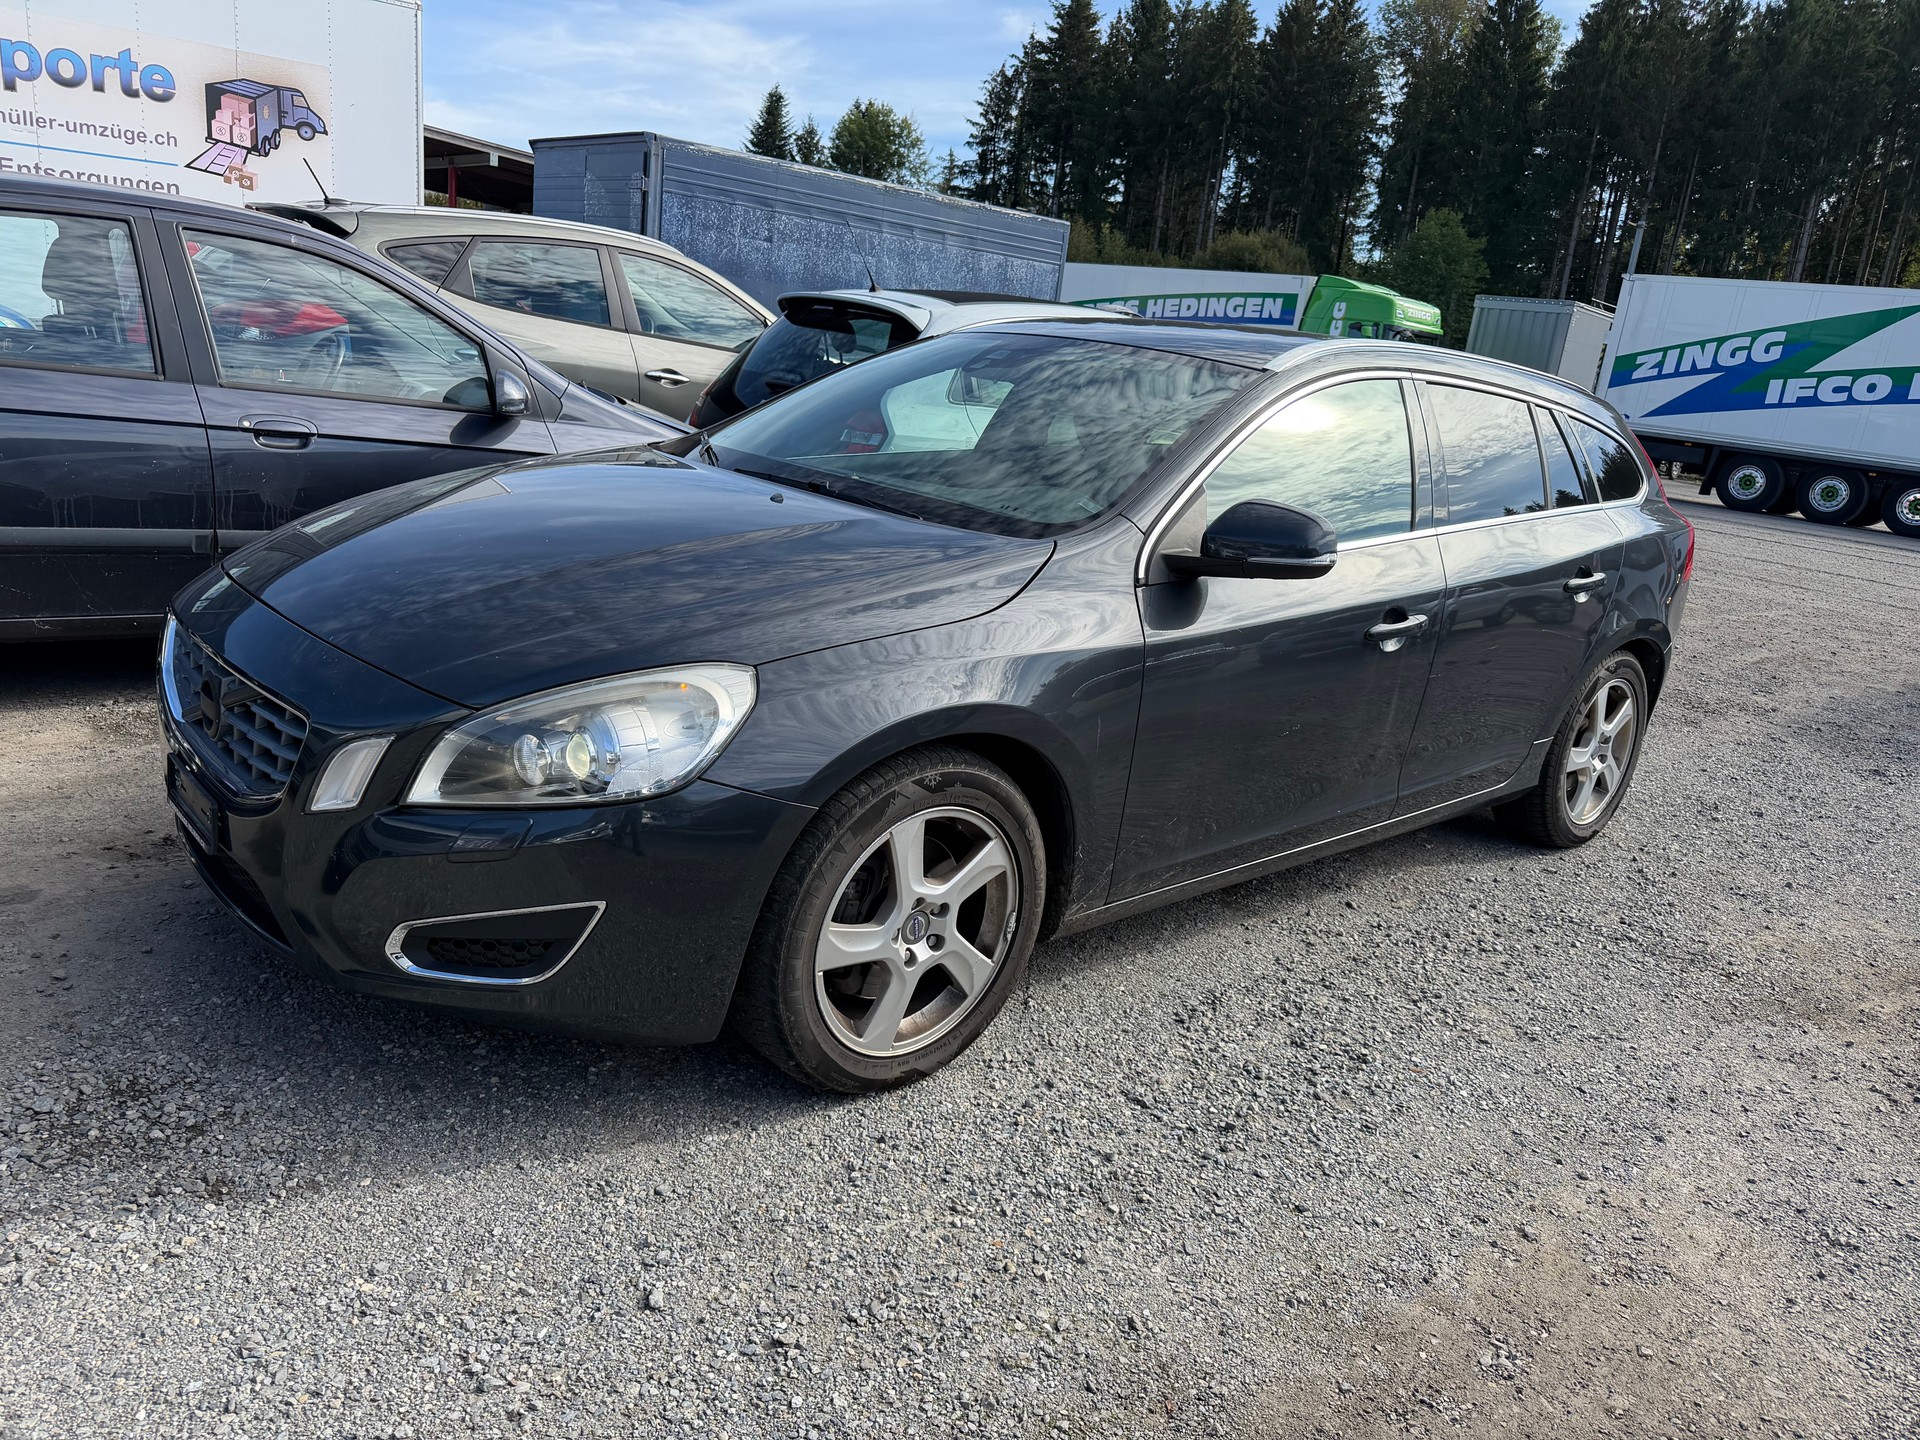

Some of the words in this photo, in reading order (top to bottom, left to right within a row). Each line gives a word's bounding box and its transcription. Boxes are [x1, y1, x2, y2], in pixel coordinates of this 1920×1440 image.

[0, 37, 177, 103] porte
[1145, 296, 1283, 319] HEDINGEN
[1407, 308, 1432, 320] ZINGG
[1631, 331, 1787, 380] ZINGG
[1764, 374, 1893, 404] IFCO
